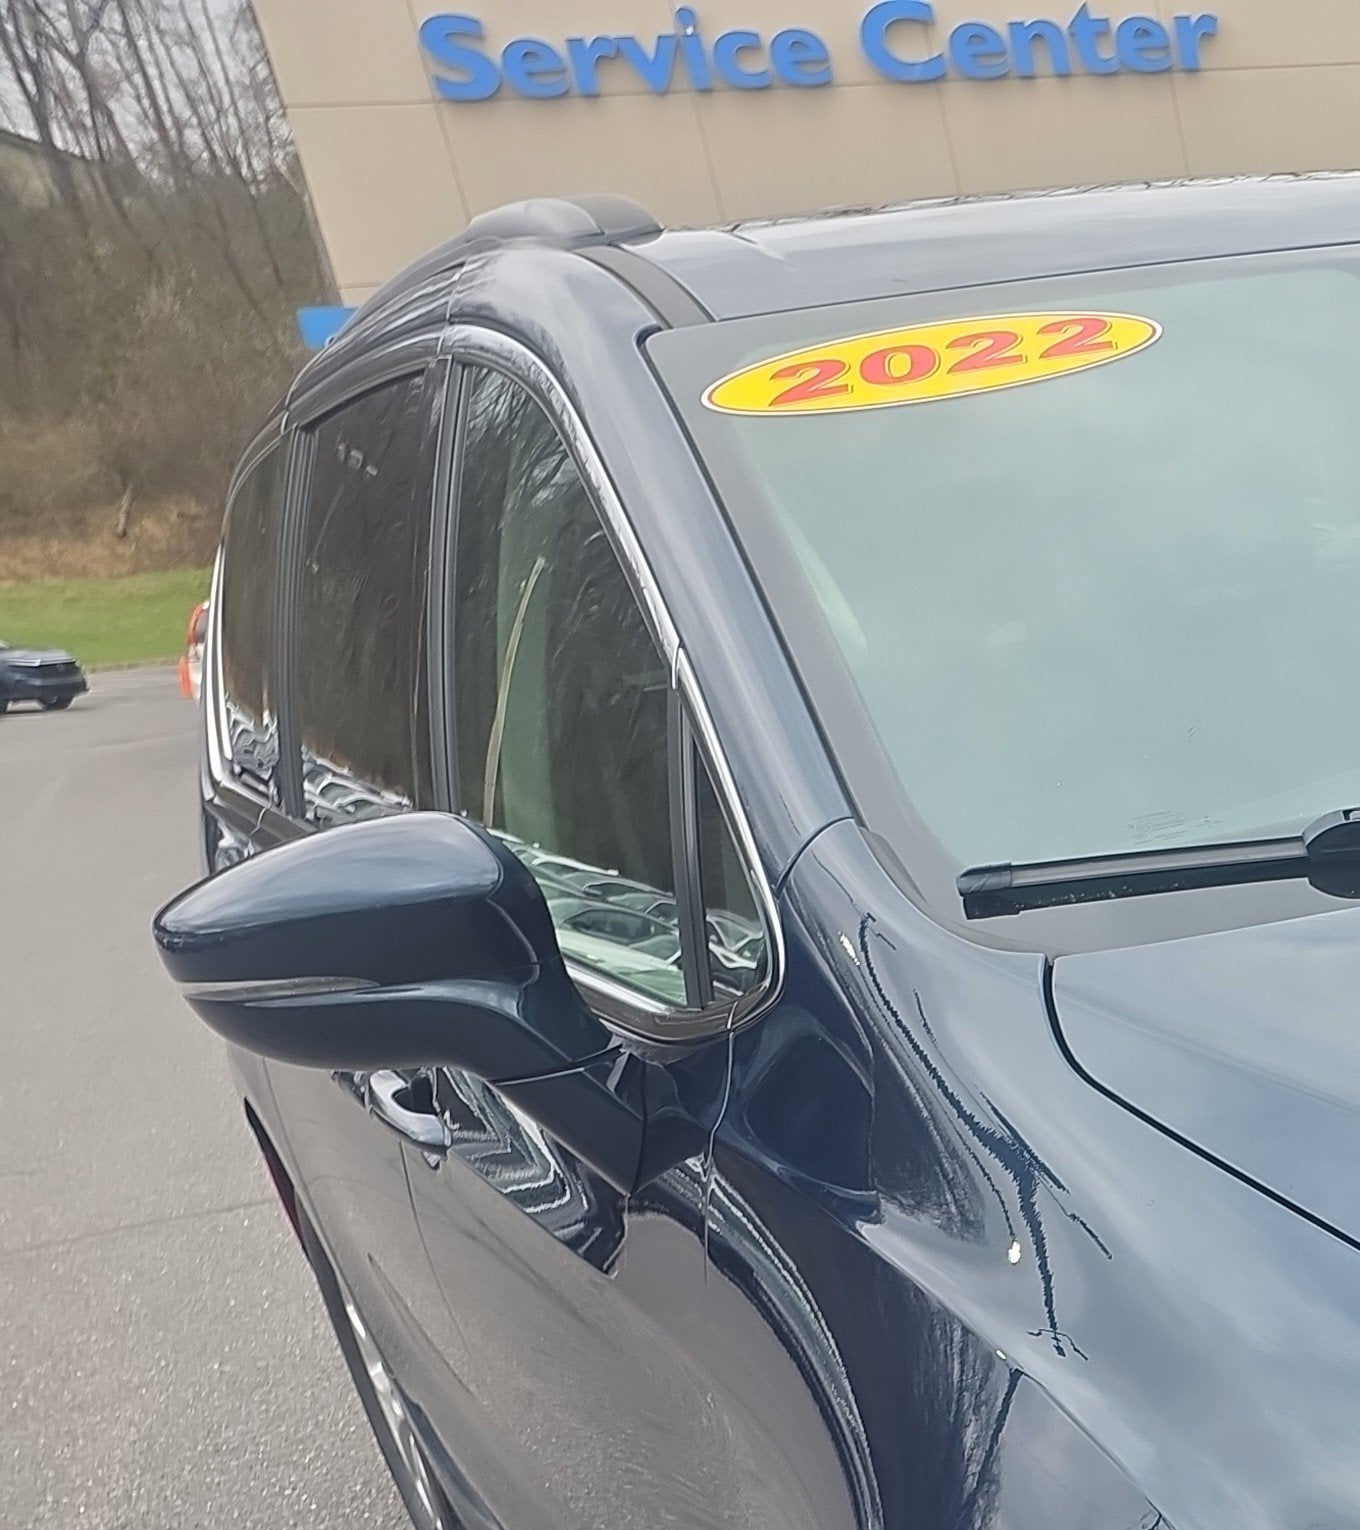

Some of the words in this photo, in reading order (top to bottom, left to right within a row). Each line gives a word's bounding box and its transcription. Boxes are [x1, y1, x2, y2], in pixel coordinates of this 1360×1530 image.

[418, 5, 834, 101] Service
[859, 0, 1219, 82] Center
[768, 317, 1119, 407] 2022
